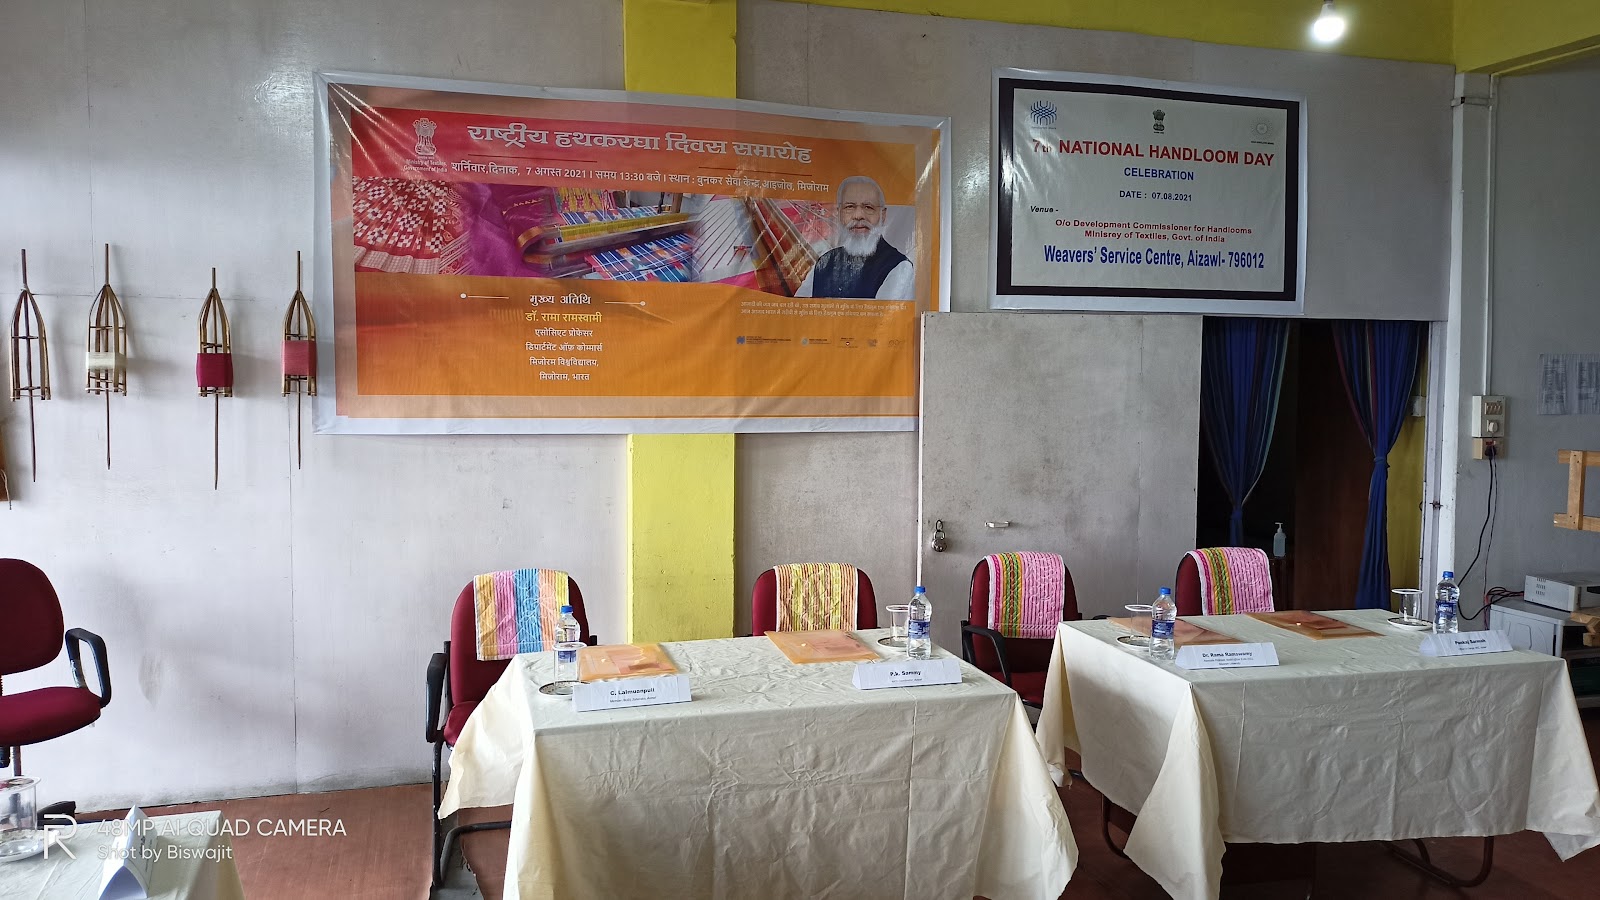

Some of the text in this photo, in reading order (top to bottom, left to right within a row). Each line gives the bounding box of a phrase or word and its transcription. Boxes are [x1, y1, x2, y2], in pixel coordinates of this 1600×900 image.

[467, 122, 813, 164] राष्ट्रीय हथकरघा दिवस समारोह
[1060, 141, 1145, 158] NATIONAL
[1150, 145, 1239, 165] HANDLOOM
[1244, 152, 1275, 167] DAY
[526, 168, 532, 177] 7
[536, 167, 563, 179] अगस्त
[564, 169, 587, 179] 2021
[596, 170, 618, 181] समय
[619, 172, 644, 183] 13:30
[669, 174, 691, 184] स्थान
[725, 175, 741, 186] सेवा
[797, 180, 830, 192] मिजोराम
[1123, 167, 1194, 181] CELEBRATION
[1120, 190, 1142, 199] DATE
[1151, 192, 1192, 202] 07.08.2021
[1030, 205, 1054, 213] Venue
[1055, 219, 1252, 235] O/o Development Commissioner for Handlooms
[1124, 231, 1134, 239] of
[1136, 231, 1168, 241] Textiles,
[1171, 233, 1193, 242] Govt.
[1195, 234, 1204, 242] of
[1205, 235, 1226, 243] India
[1044, 245, 1097, 263] Weavers'
[1100, 247, 1142, 264] Service
[1145, 248, 1184, 268] Centre,
[1228, 252, 1264, 269] 796012
[529, 293, 591, 307] मुख्य अतिथि
[525, 310, 603, 323] डॉ. रामा रामस्वामी
[535, 327, 567, 338] एसोसिएट
[529, 356, 557, 366] मिजोरम
[539, 370, 591, 382] मिजोराम, भारत
